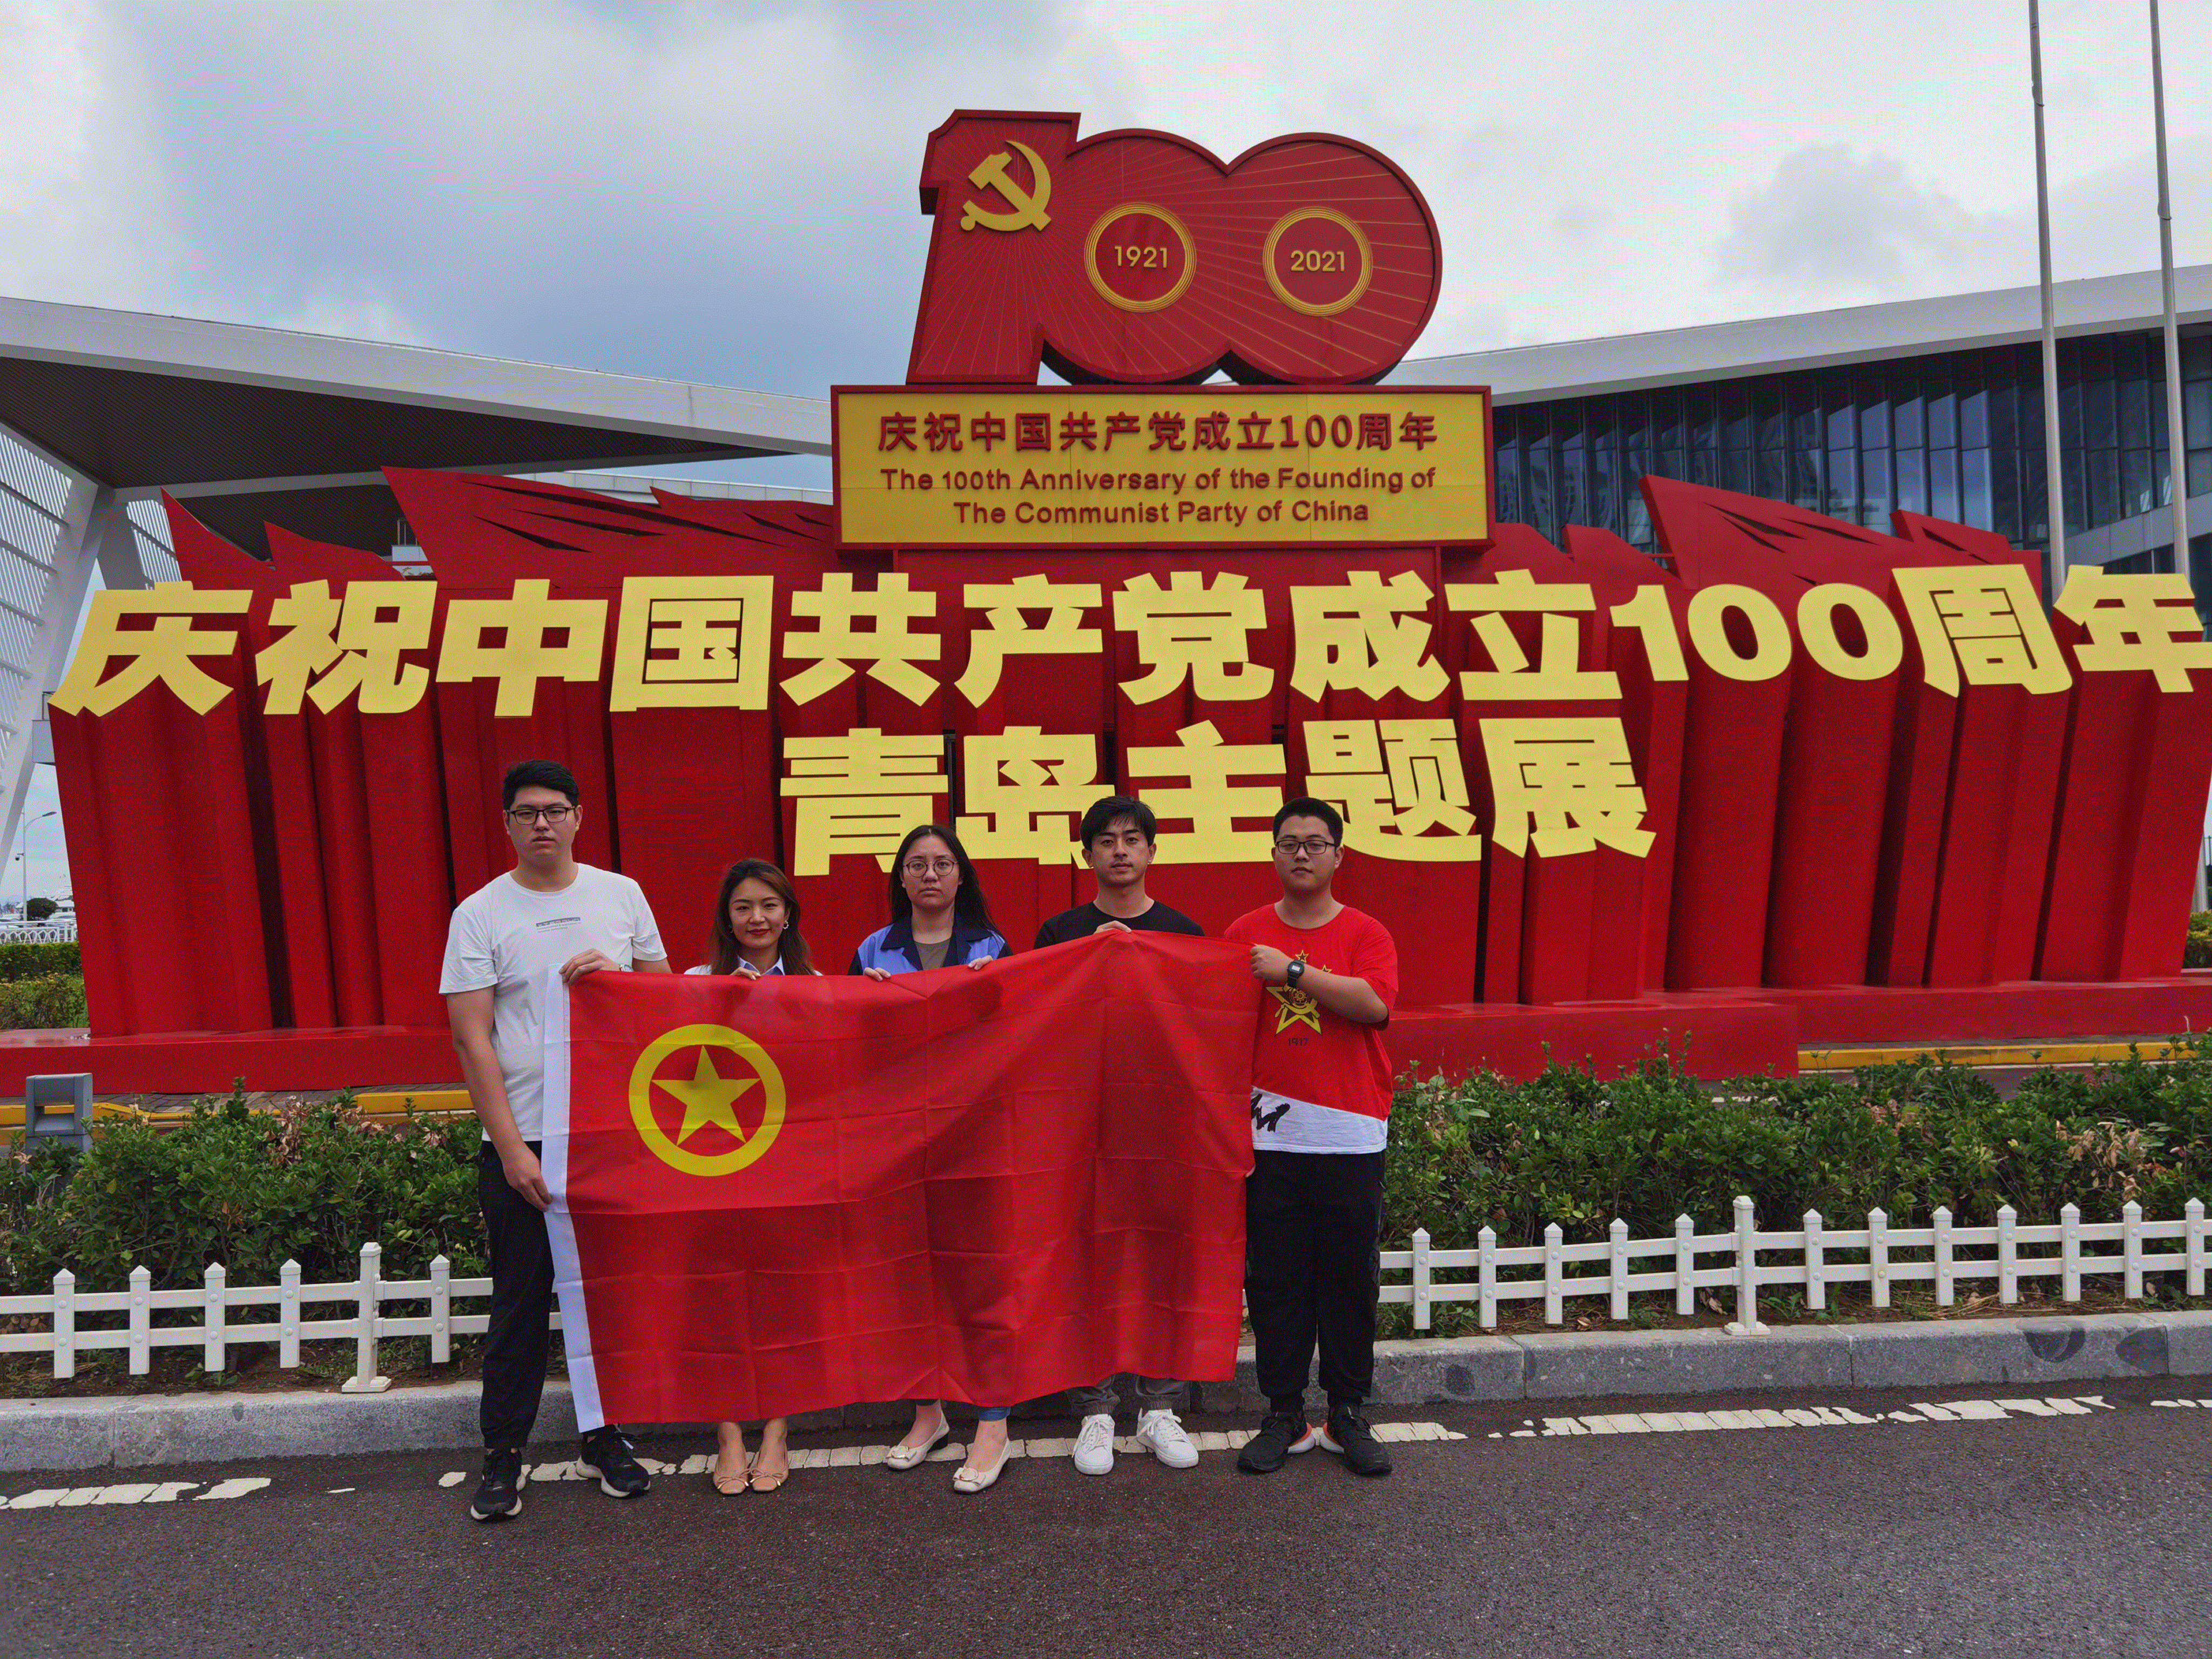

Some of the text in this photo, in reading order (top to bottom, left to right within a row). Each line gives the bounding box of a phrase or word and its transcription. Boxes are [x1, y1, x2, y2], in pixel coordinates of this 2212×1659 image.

[1114, 245, 1168, 268] 1921
[1290, 248, 1345, 272] 2021
[878, 411, 1438, 453] 庆祝中国共产党成立100周年
[880, 467, 1437, 495] The 100th Anniversary of the Founding of
[953, 500, 1370, 528] The Communist Party of China
[49, 565, 2212, 717] 庆祝中国共产党成立100周年
[780, 718, 1656, 876] 青岛主题展
